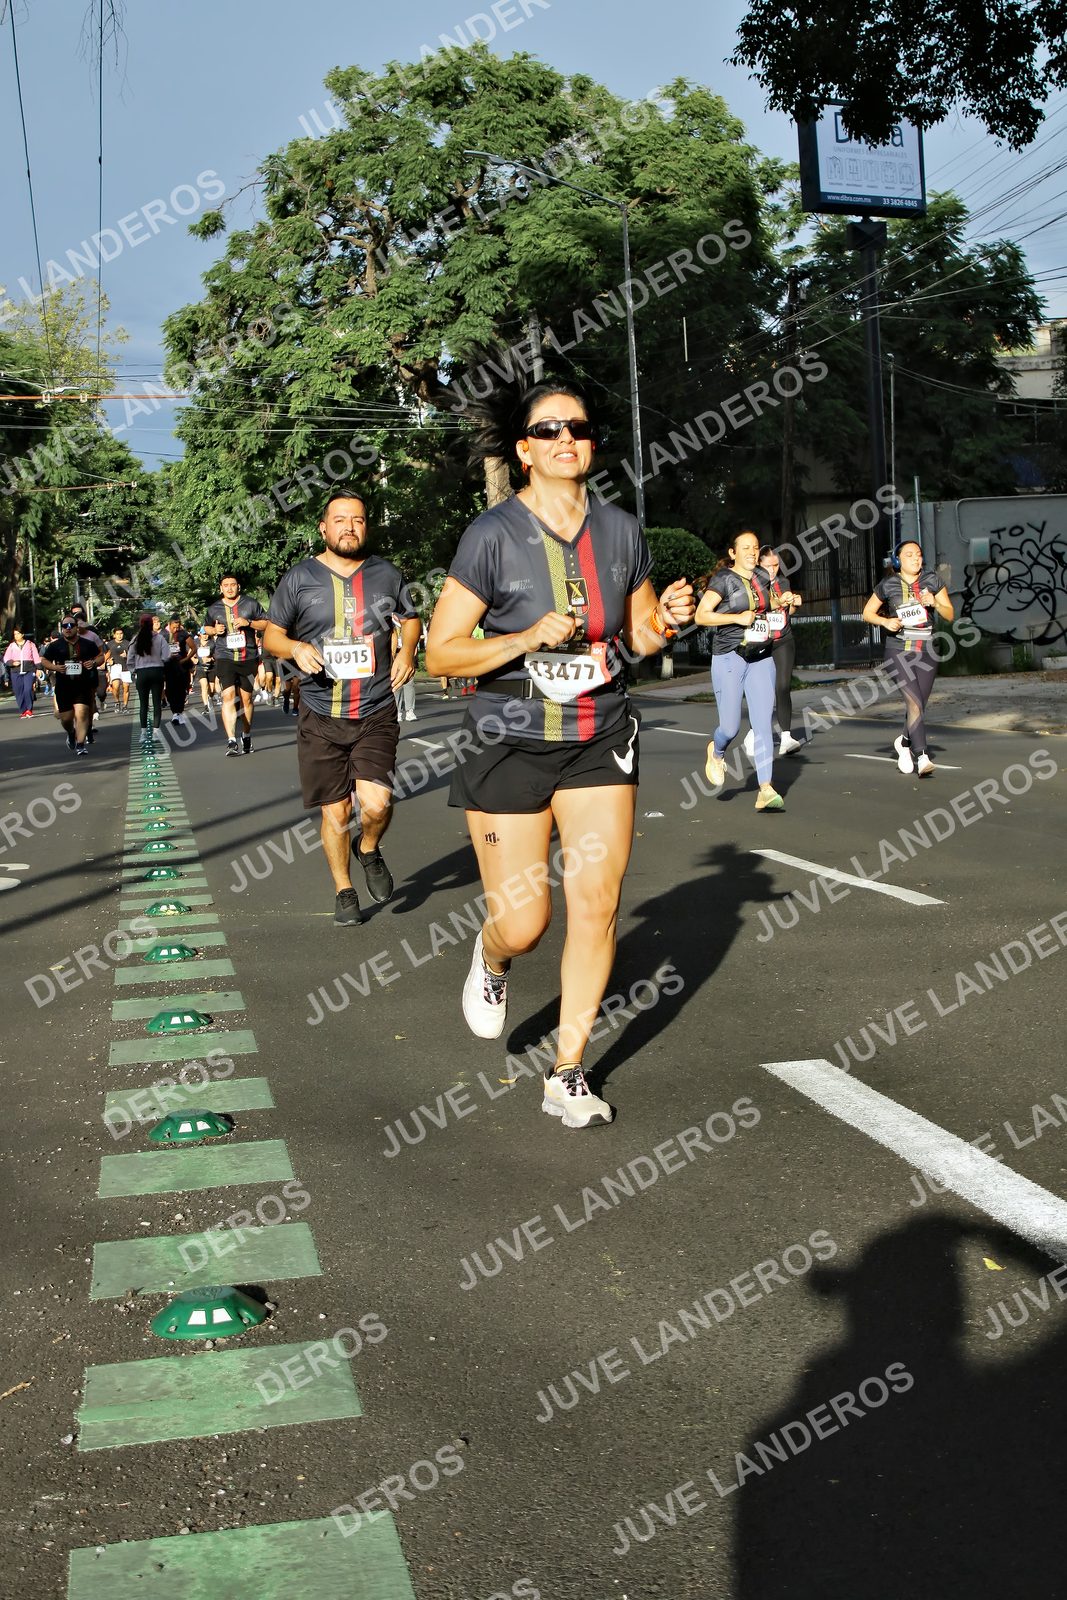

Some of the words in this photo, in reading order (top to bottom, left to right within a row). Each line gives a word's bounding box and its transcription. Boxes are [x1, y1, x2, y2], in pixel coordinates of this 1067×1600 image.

[990, 521, 1047, 542] TOY
[900, 608, 922, 619] 8866
[326, 649, 368, 665] 10915
[528, 660, 595, 681] 13477
